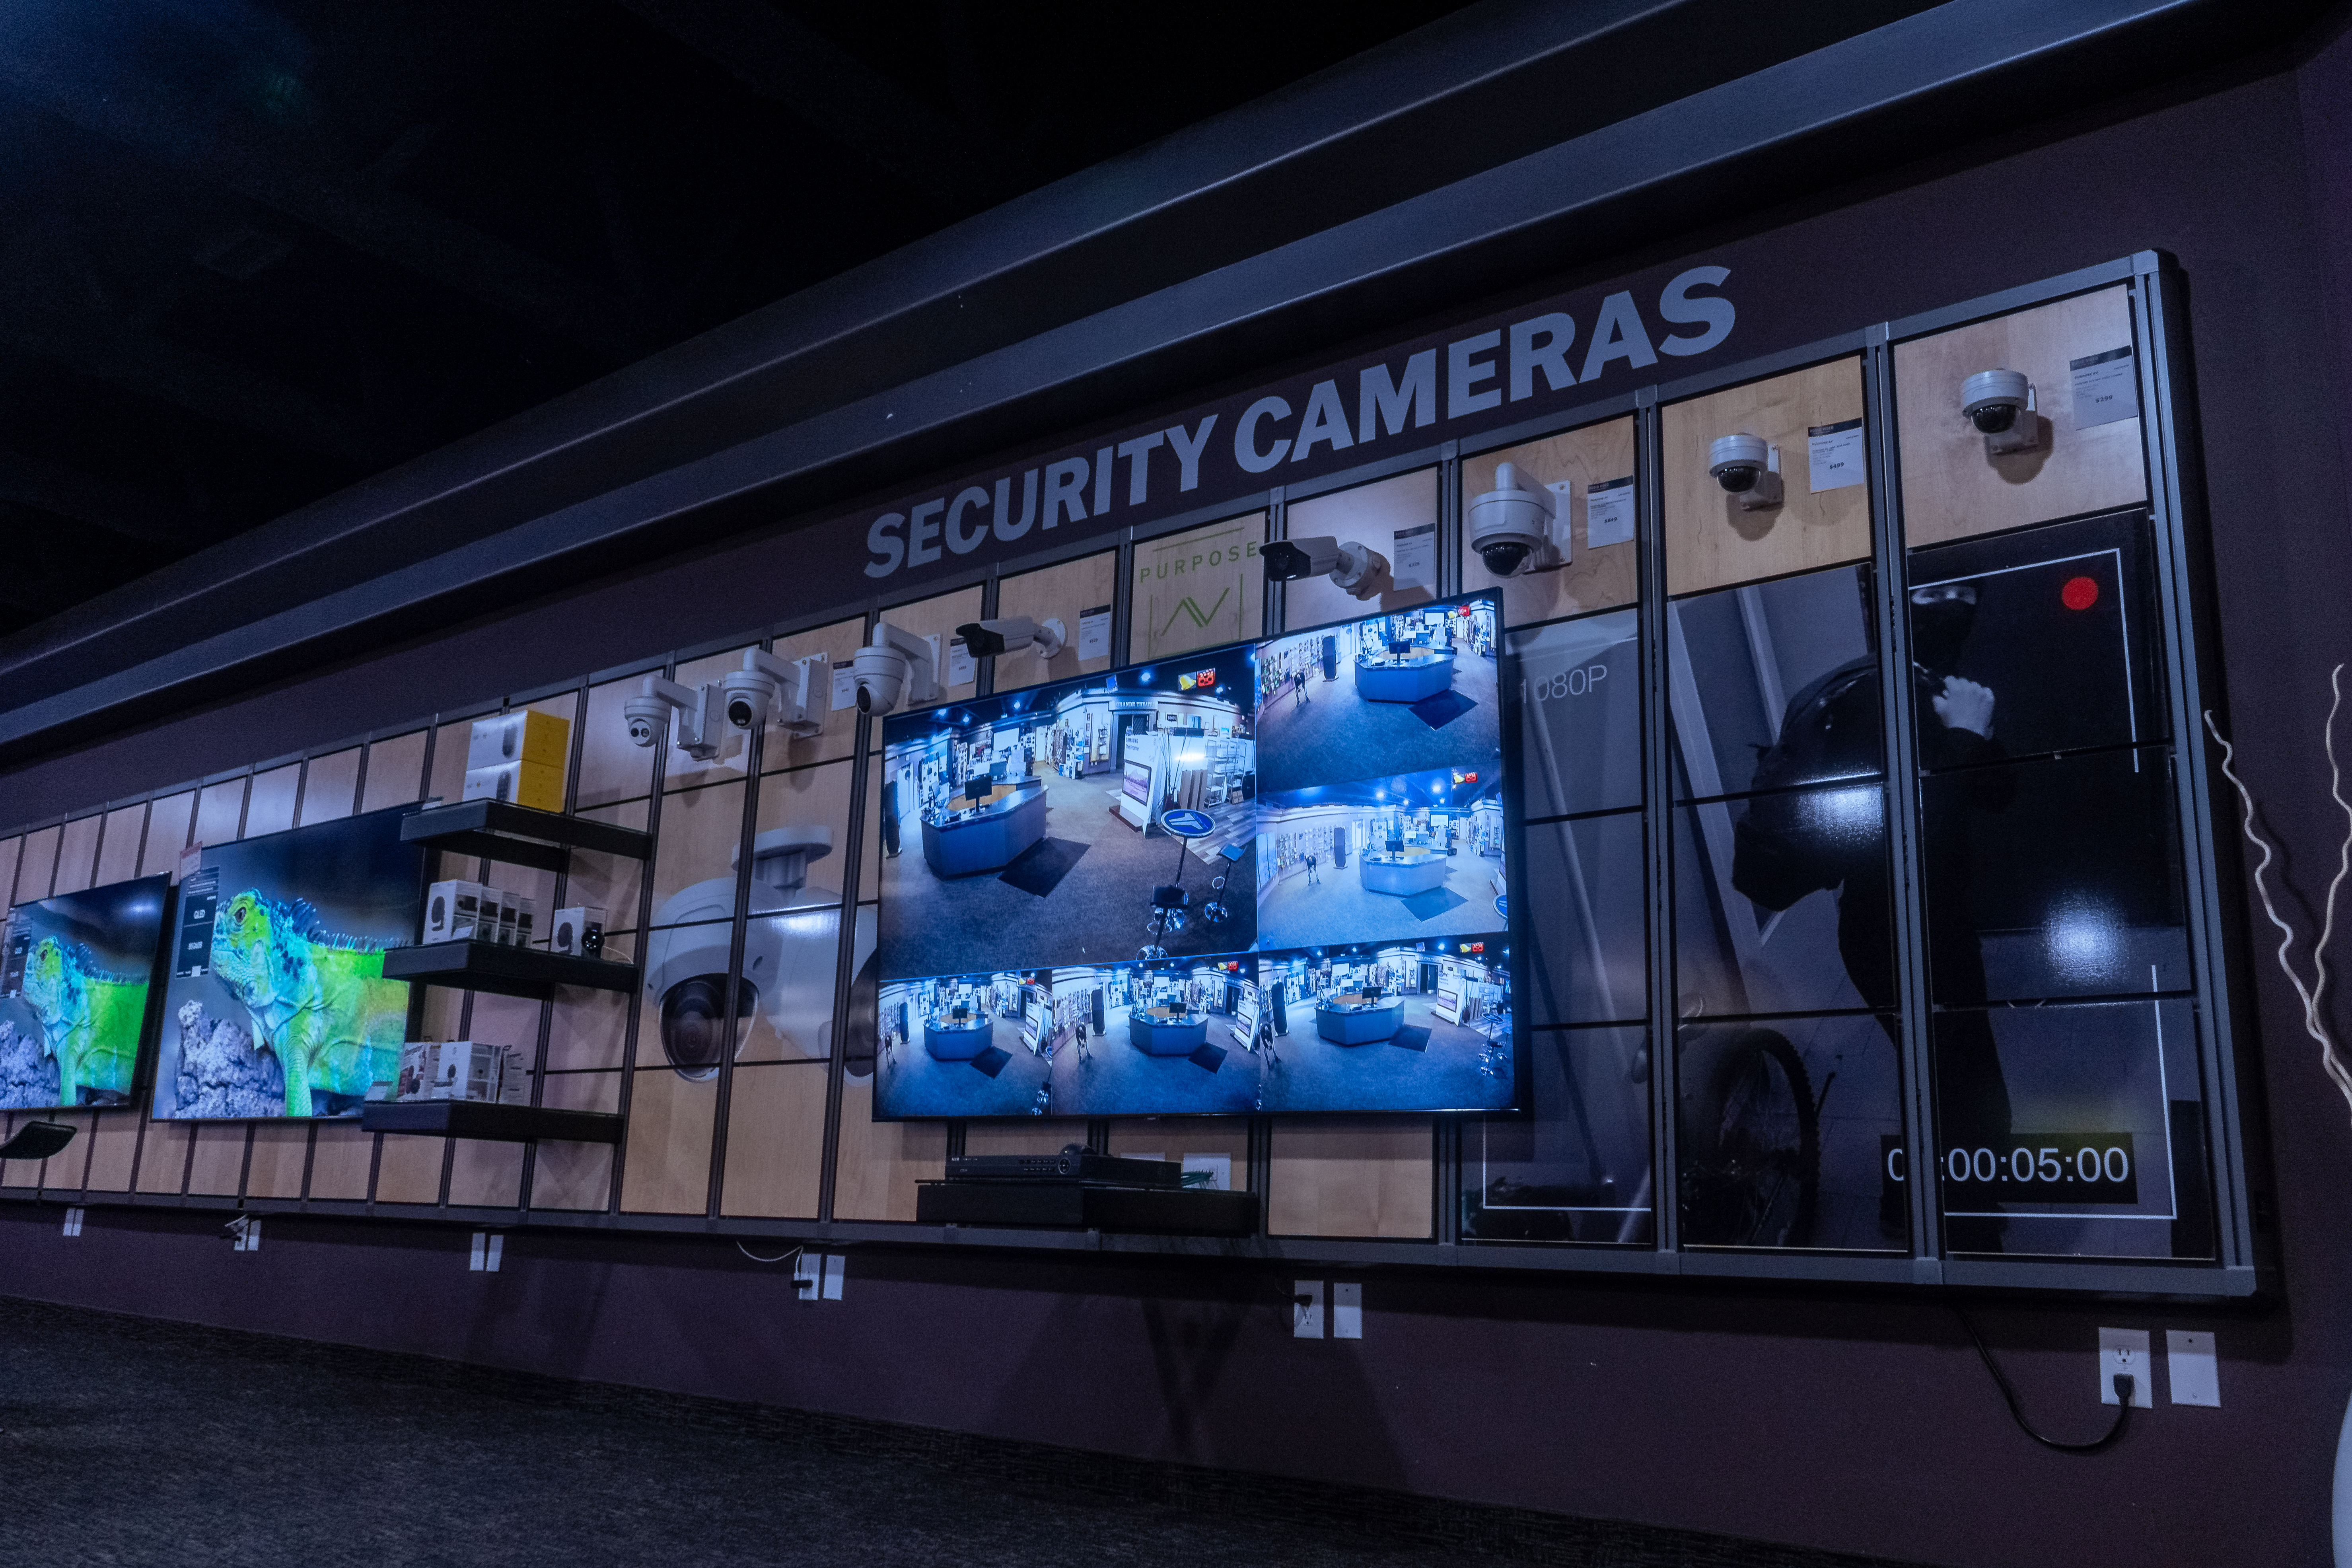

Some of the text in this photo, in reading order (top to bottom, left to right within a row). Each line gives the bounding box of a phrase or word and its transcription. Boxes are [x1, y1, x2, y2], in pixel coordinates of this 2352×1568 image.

[2095, 395, 2113, 403] $299
[864, 266, 1736, 578] SECURITY CAMERAS
[1829, 461, 1844, 470] $499
[1139, 540, 1257, 584] PURPOSE
[1521, 664, 1607, 704] 1080P
[1887, 1147, 2129, 1183] 0:00:05:00
